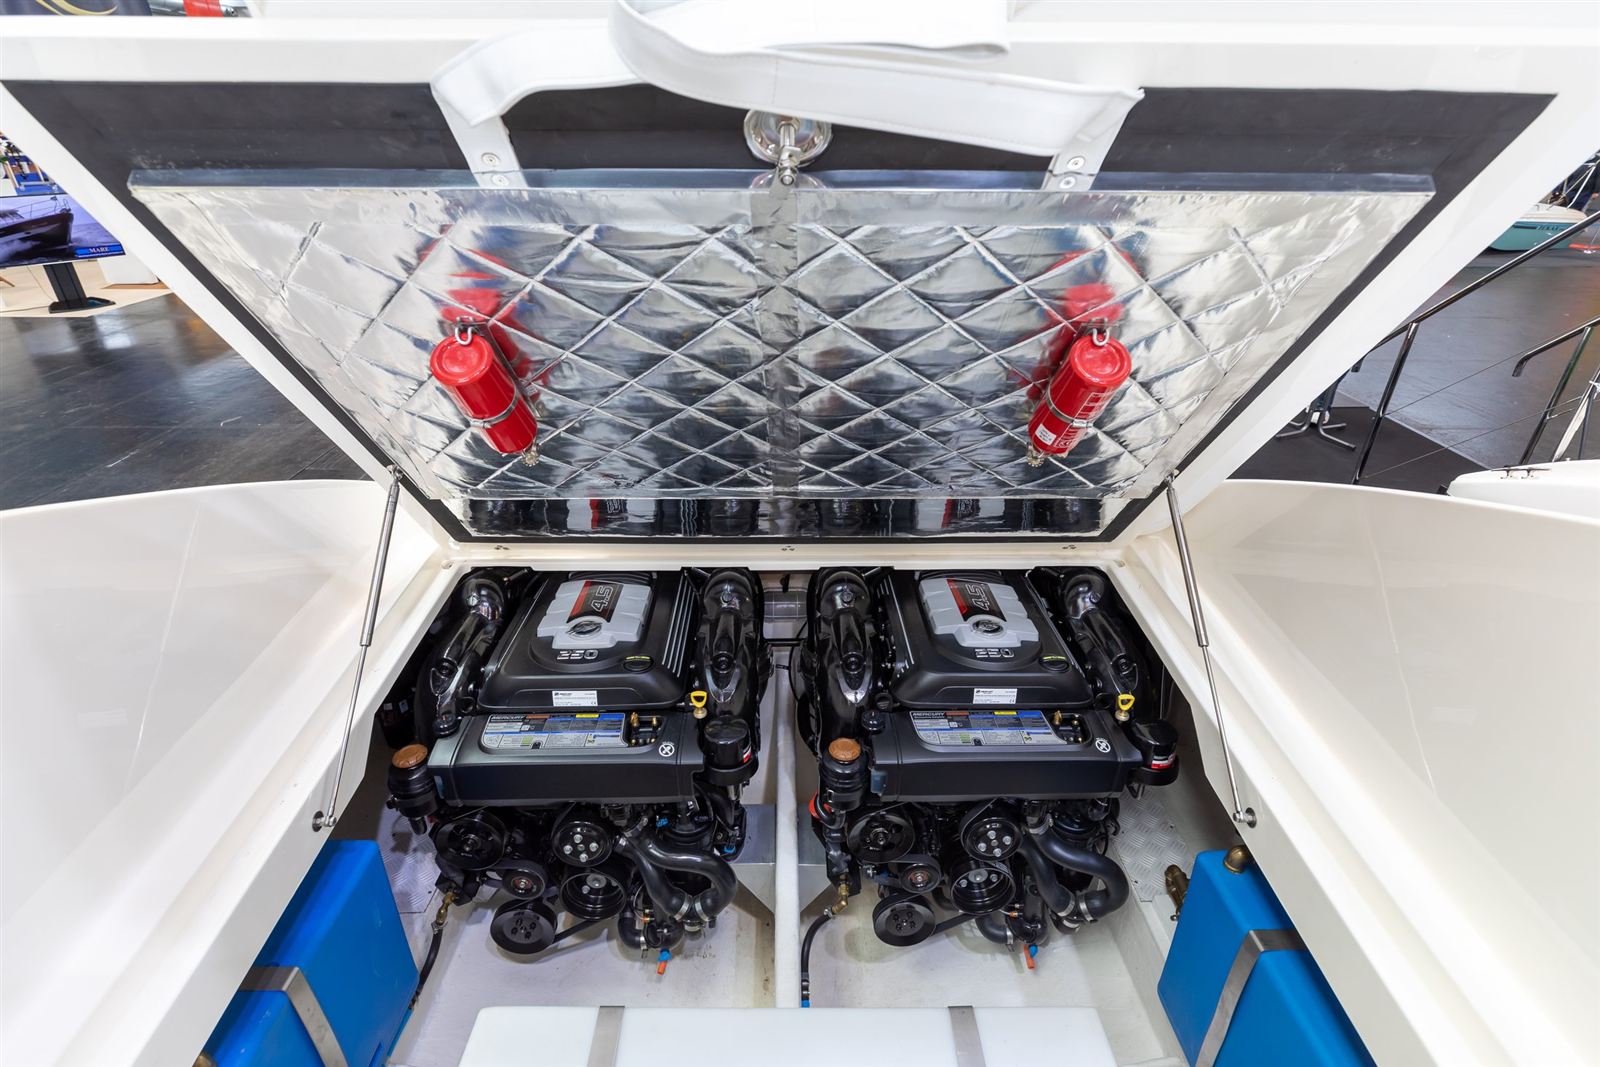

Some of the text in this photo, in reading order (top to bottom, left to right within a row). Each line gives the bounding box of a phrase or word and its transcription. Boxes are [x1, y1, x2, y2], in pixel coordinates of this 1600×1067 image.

[591, 585, 613, 612] 4.5
[965, 584, 990, 611] 4.5
[557, 649, 599, 660] 250
[975, 648, 1015, 658] 250
